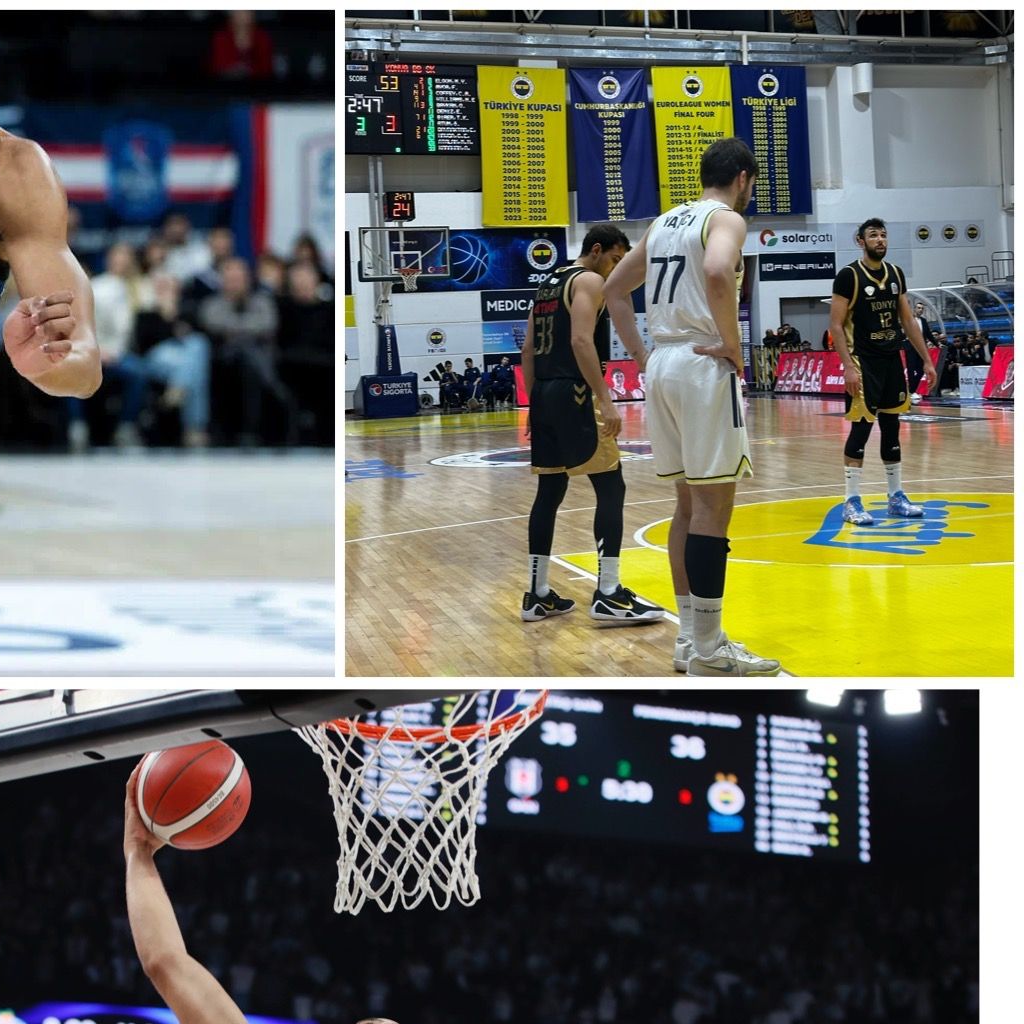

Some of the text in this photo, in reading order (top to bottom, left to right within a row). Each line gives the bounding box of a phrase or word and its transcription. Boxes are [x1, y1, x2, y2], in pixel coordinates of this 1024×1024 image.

[380, 76, 399, 90] 53
[347, 98, 381, 113] 2:47
[484, 101, 562, 111] TÜRKİYE KUPASI
[742, 97, 796, 106] TÜRKİYE LİGİ
[356, 116, 366, 132] 3
[386, 115, 396, 132] 3
[392, 202, 411, 217] 24
[782, 233, 833, 246] solarçatı
[650, 255, 686, 305] 77
[879, 312, 892, 328] 12
[534, 316, 554, 356] 33
